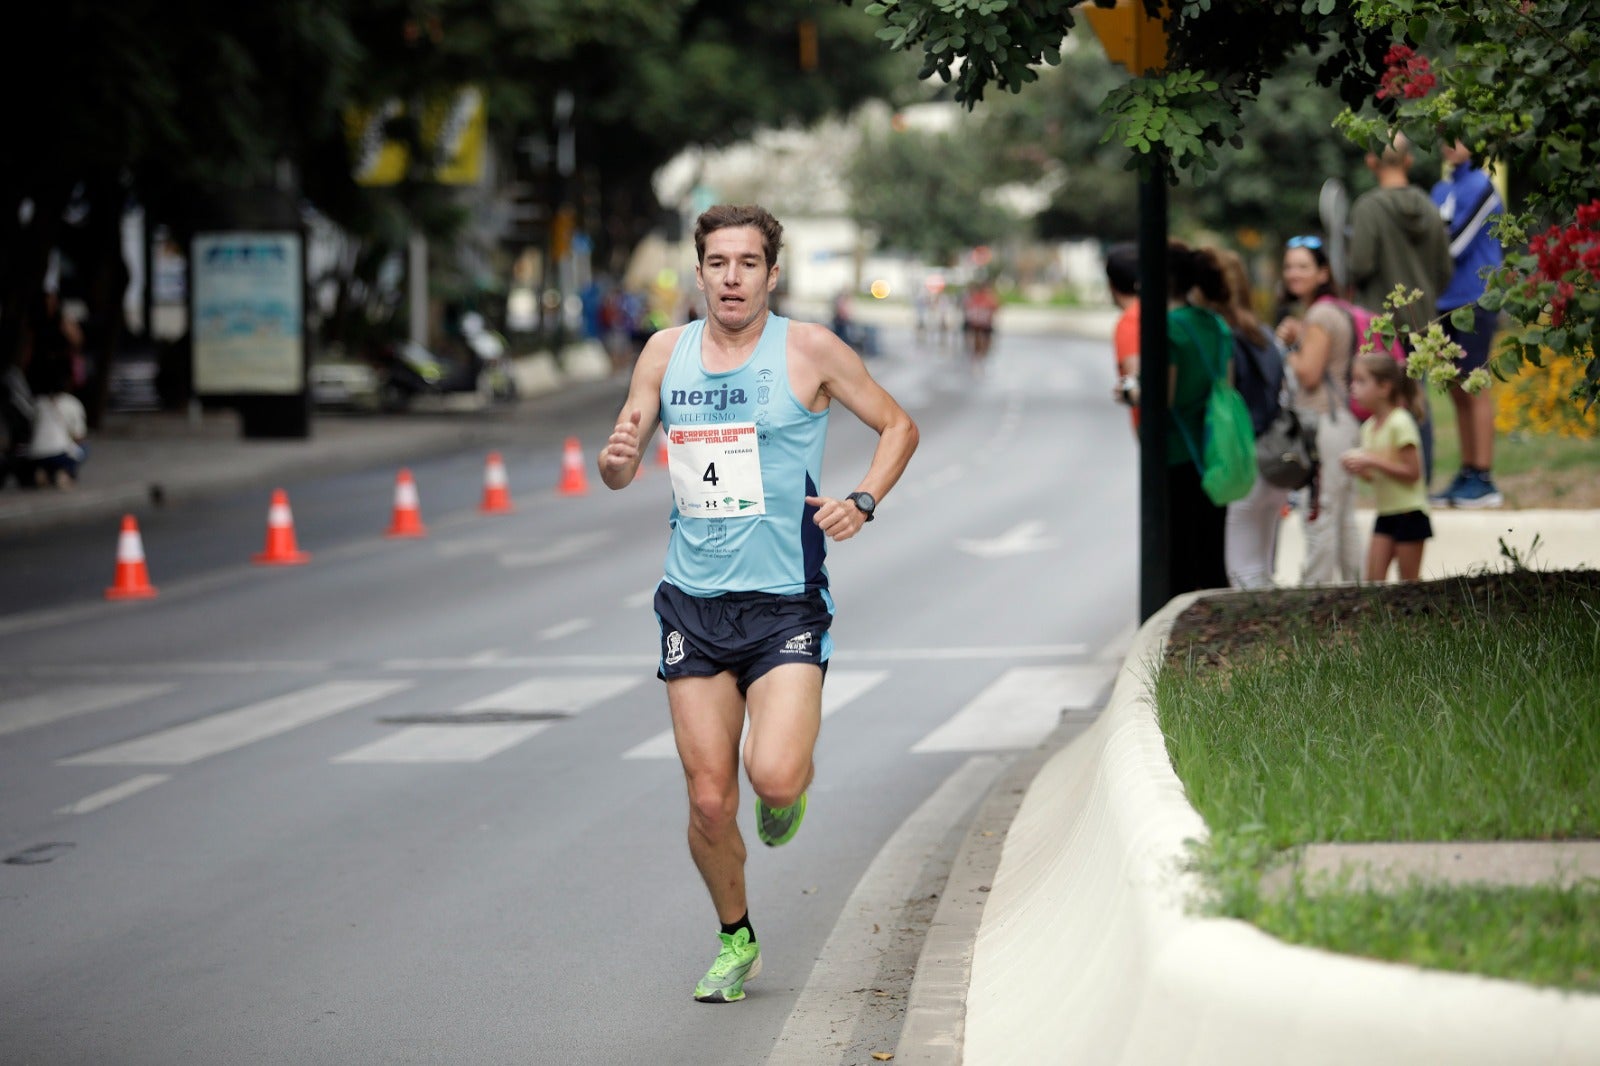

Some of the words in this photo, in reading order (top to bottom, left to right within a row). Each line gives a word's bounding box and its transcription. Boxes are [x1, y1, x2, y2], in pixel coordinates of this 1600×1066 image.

[670, 383, 748, 411] nerja
[678, 412, 736, 423] ATLETISMO
[669, 430, 684, 444] 42
[684, 429, 719, 438] CARRERA
[721, 427, 755, 436] URBANA
[705, 436, 738, 444] MALAGA
[702, 461, 719, 487] 4
